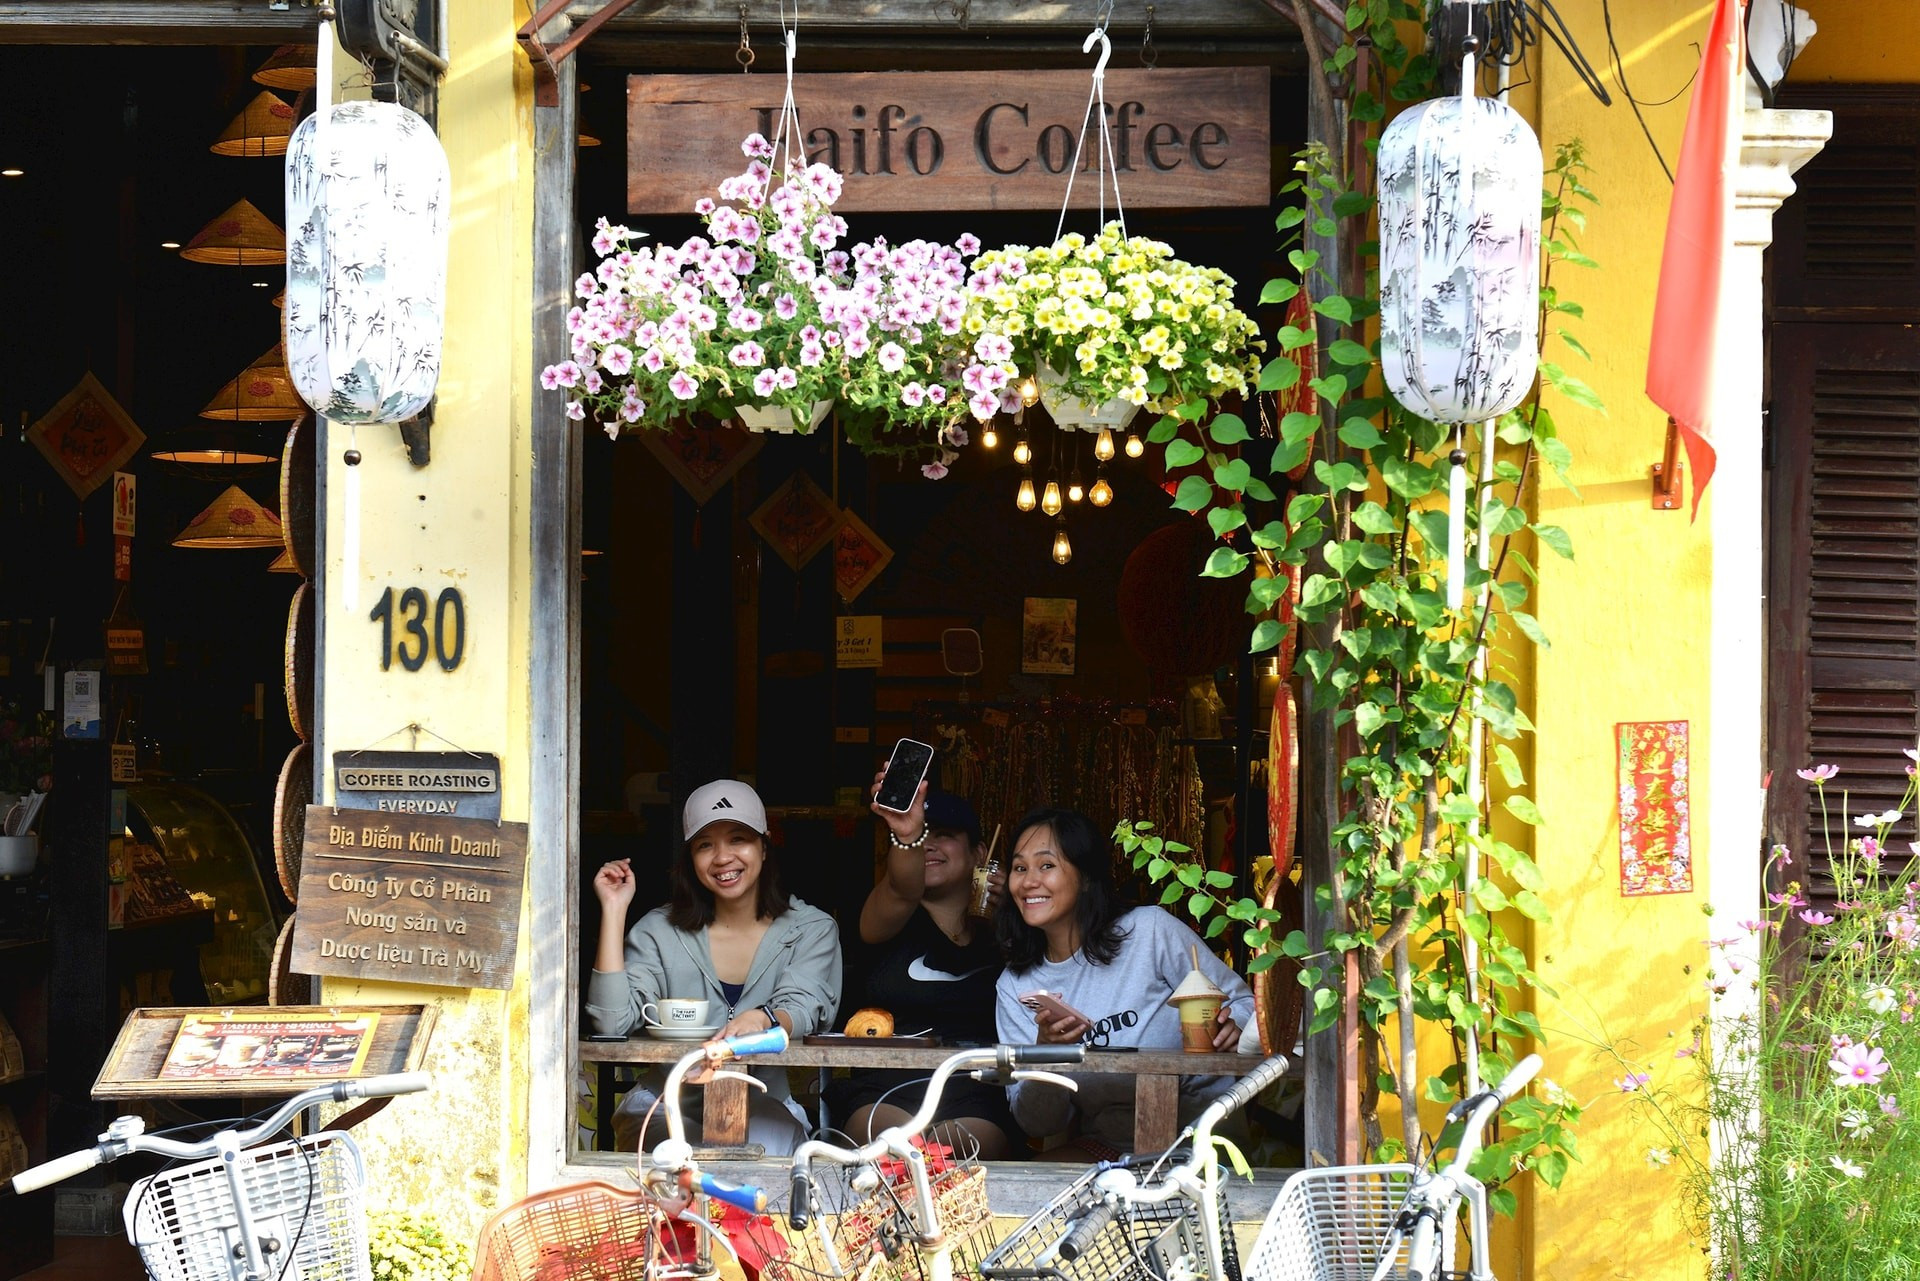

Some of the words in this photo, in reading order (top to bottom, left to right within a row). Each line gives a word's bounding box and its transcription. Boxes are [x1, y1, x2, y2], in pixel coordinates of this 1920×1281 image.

[972, 101, 1231, 175] Coffee
[370, 586, 465, 672] 130
[345, 773, 404, 787] COFFEE
[408, 773, 491, 788] ROASTING
[378, 799, 459, 815] EVERYDAY
[329, 825, 356, 850] Địa
[361, 825, 404, 851] Điểm
[409, 831, 445, 854] Kinh
[450, 835, 502, 858] Doanh
[327, 871, 379, 898] Công
[384, 876, 403, 900] Ty
[409, 876, 437, 899] Cổ
[402, 912, 439, 933] sản
[445, 915, 468, 936] và
[377, 943, 414, 970] liệu
[420, 947, 450, 968] Trà
